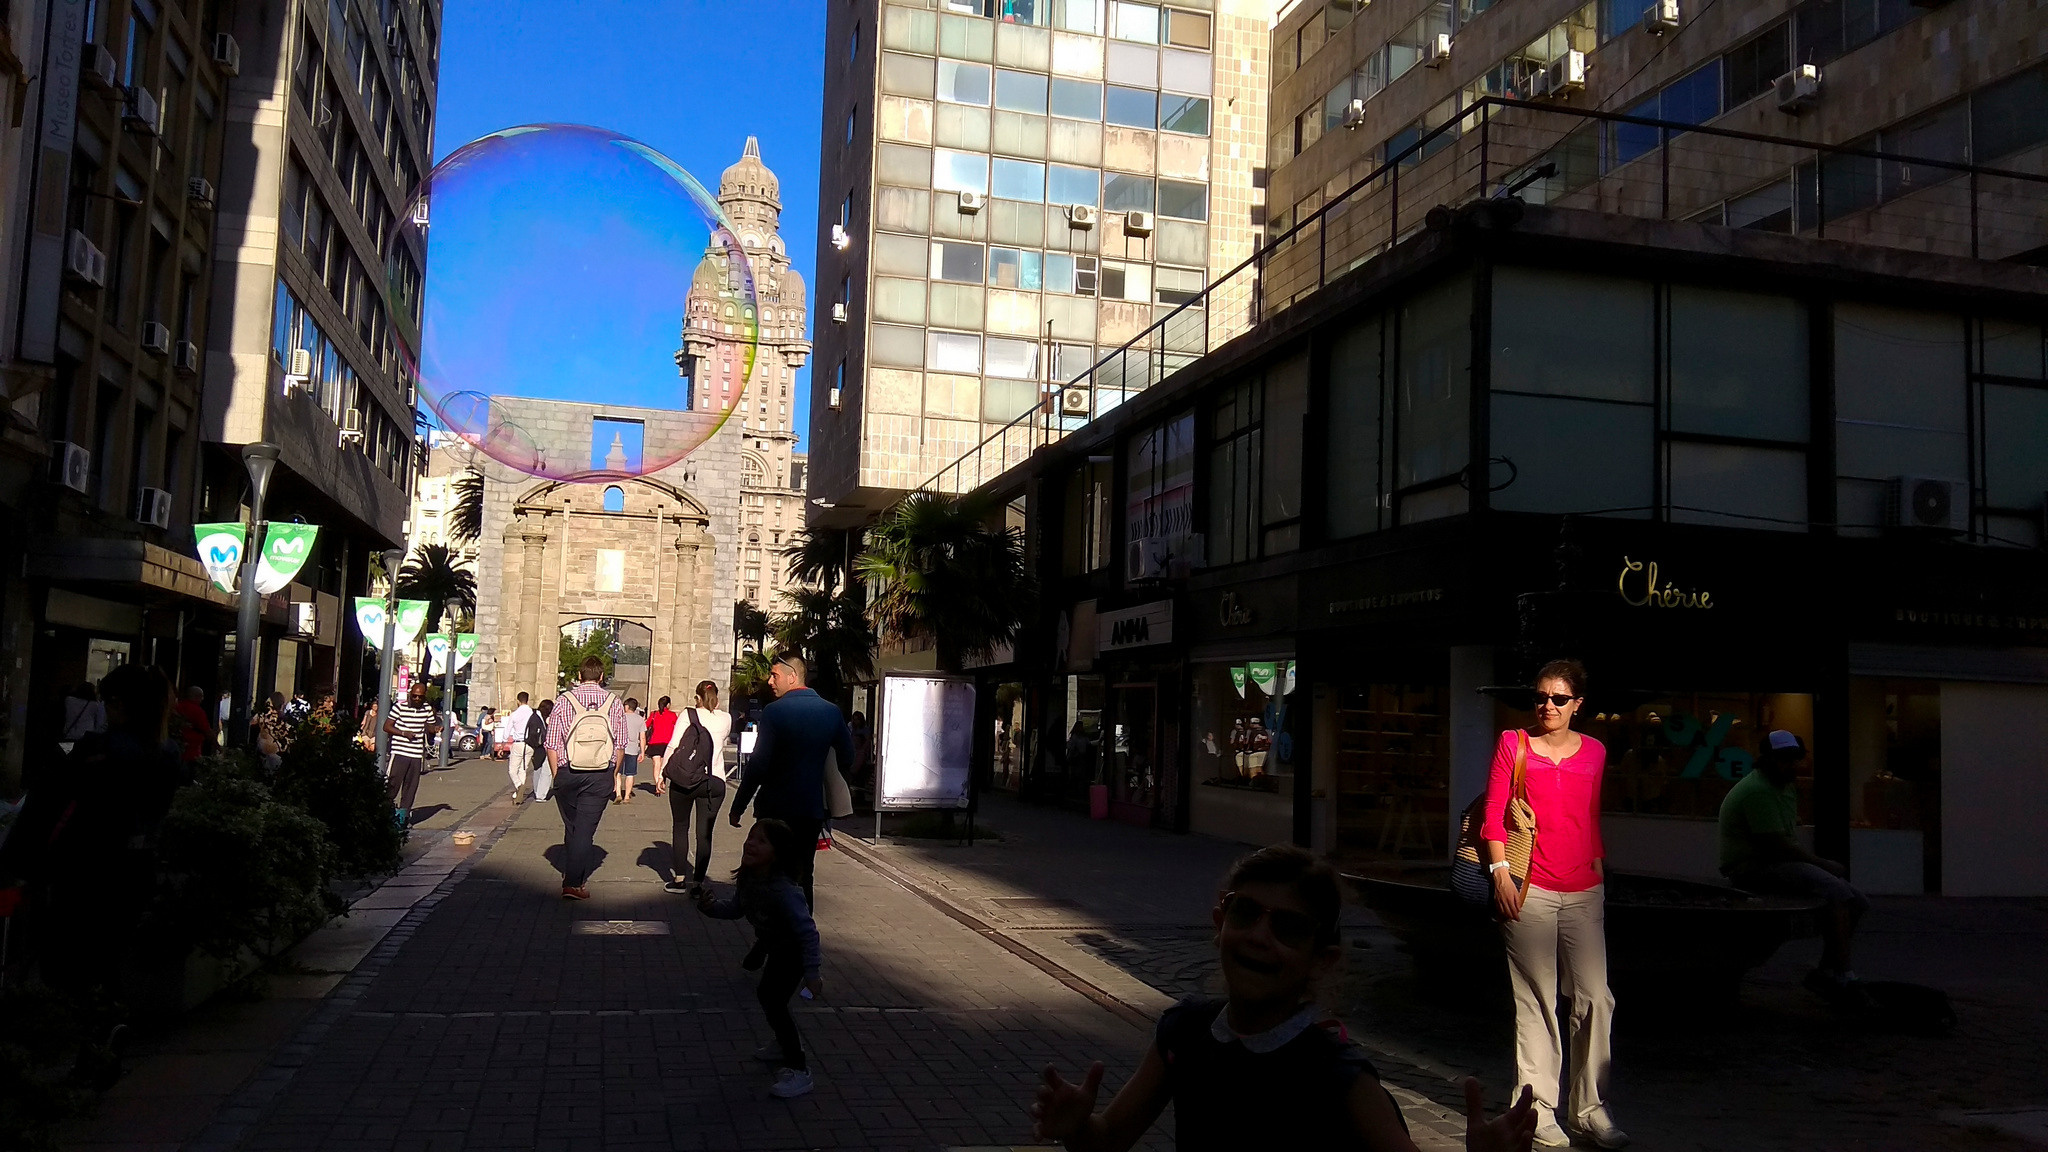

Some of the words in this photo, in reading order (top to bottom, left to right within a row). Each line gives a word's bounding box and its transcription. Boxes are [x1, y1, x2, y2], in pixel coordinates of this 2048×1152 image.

[55, 12, 78, 71] Torres
[50, 73, 71, 138] Museo
[1619, 555, 1714, 609] Chérie
